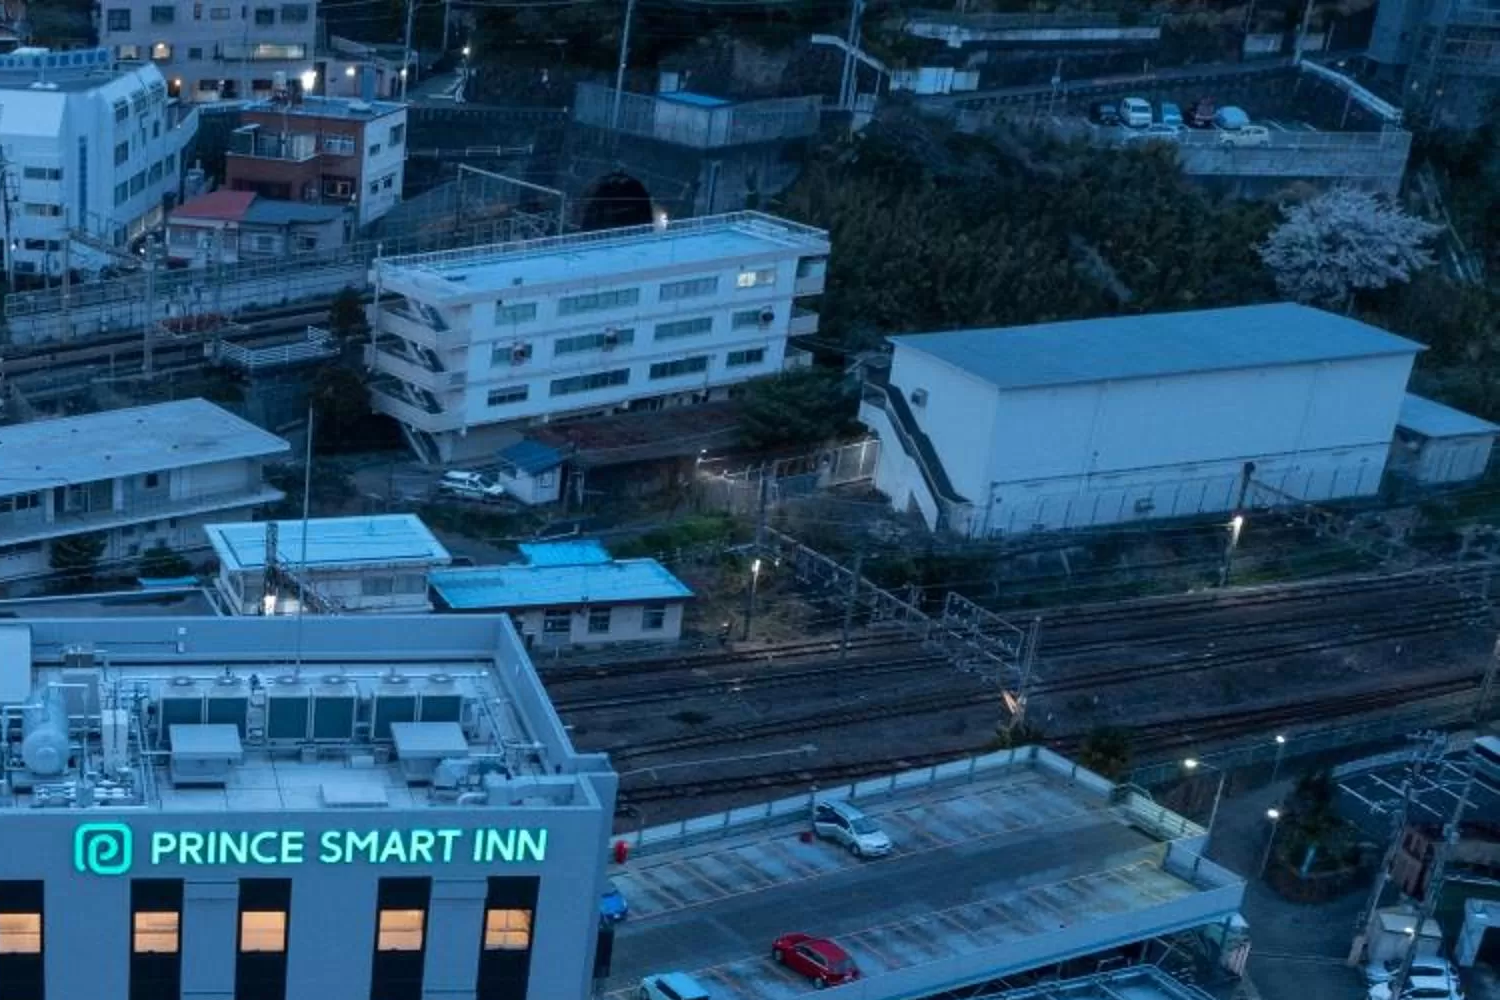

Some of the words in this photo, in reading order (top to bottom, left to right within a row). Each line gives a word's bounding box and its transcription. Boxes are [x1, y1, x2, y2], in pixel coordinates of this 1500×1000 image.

[151, 831, 305, 865] PRINCE
[319, 830, 462, 864] SMART
[473, 828, 548, 862] INN
